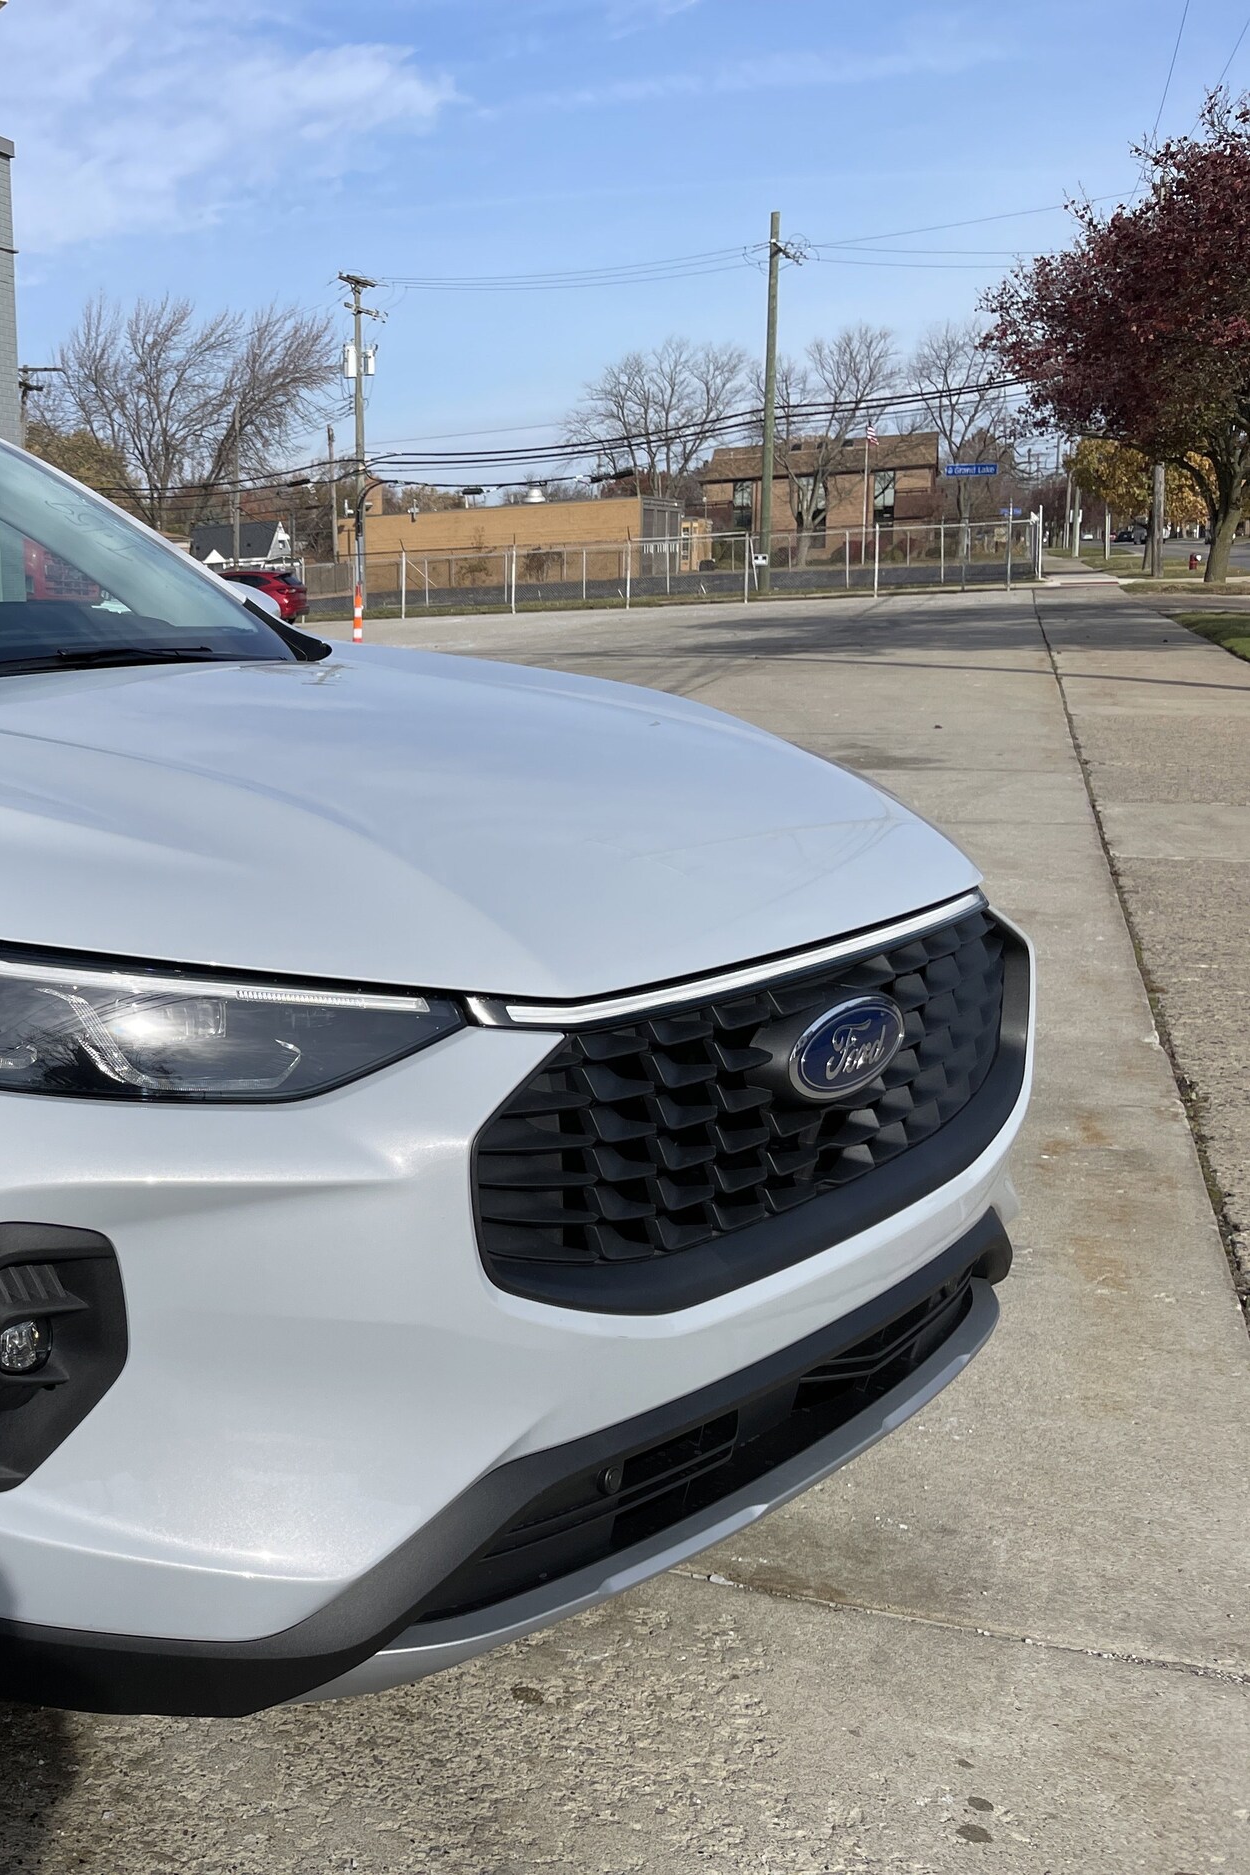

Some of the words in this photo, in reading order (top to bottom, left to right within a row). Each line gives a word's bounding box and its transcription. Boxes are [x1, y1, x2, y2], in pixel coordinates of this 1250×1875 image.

[954, 466, 976, 475] Grand
[977, 466, 996, 474] Lake
[825, 1019, 886, 1080] Ford
